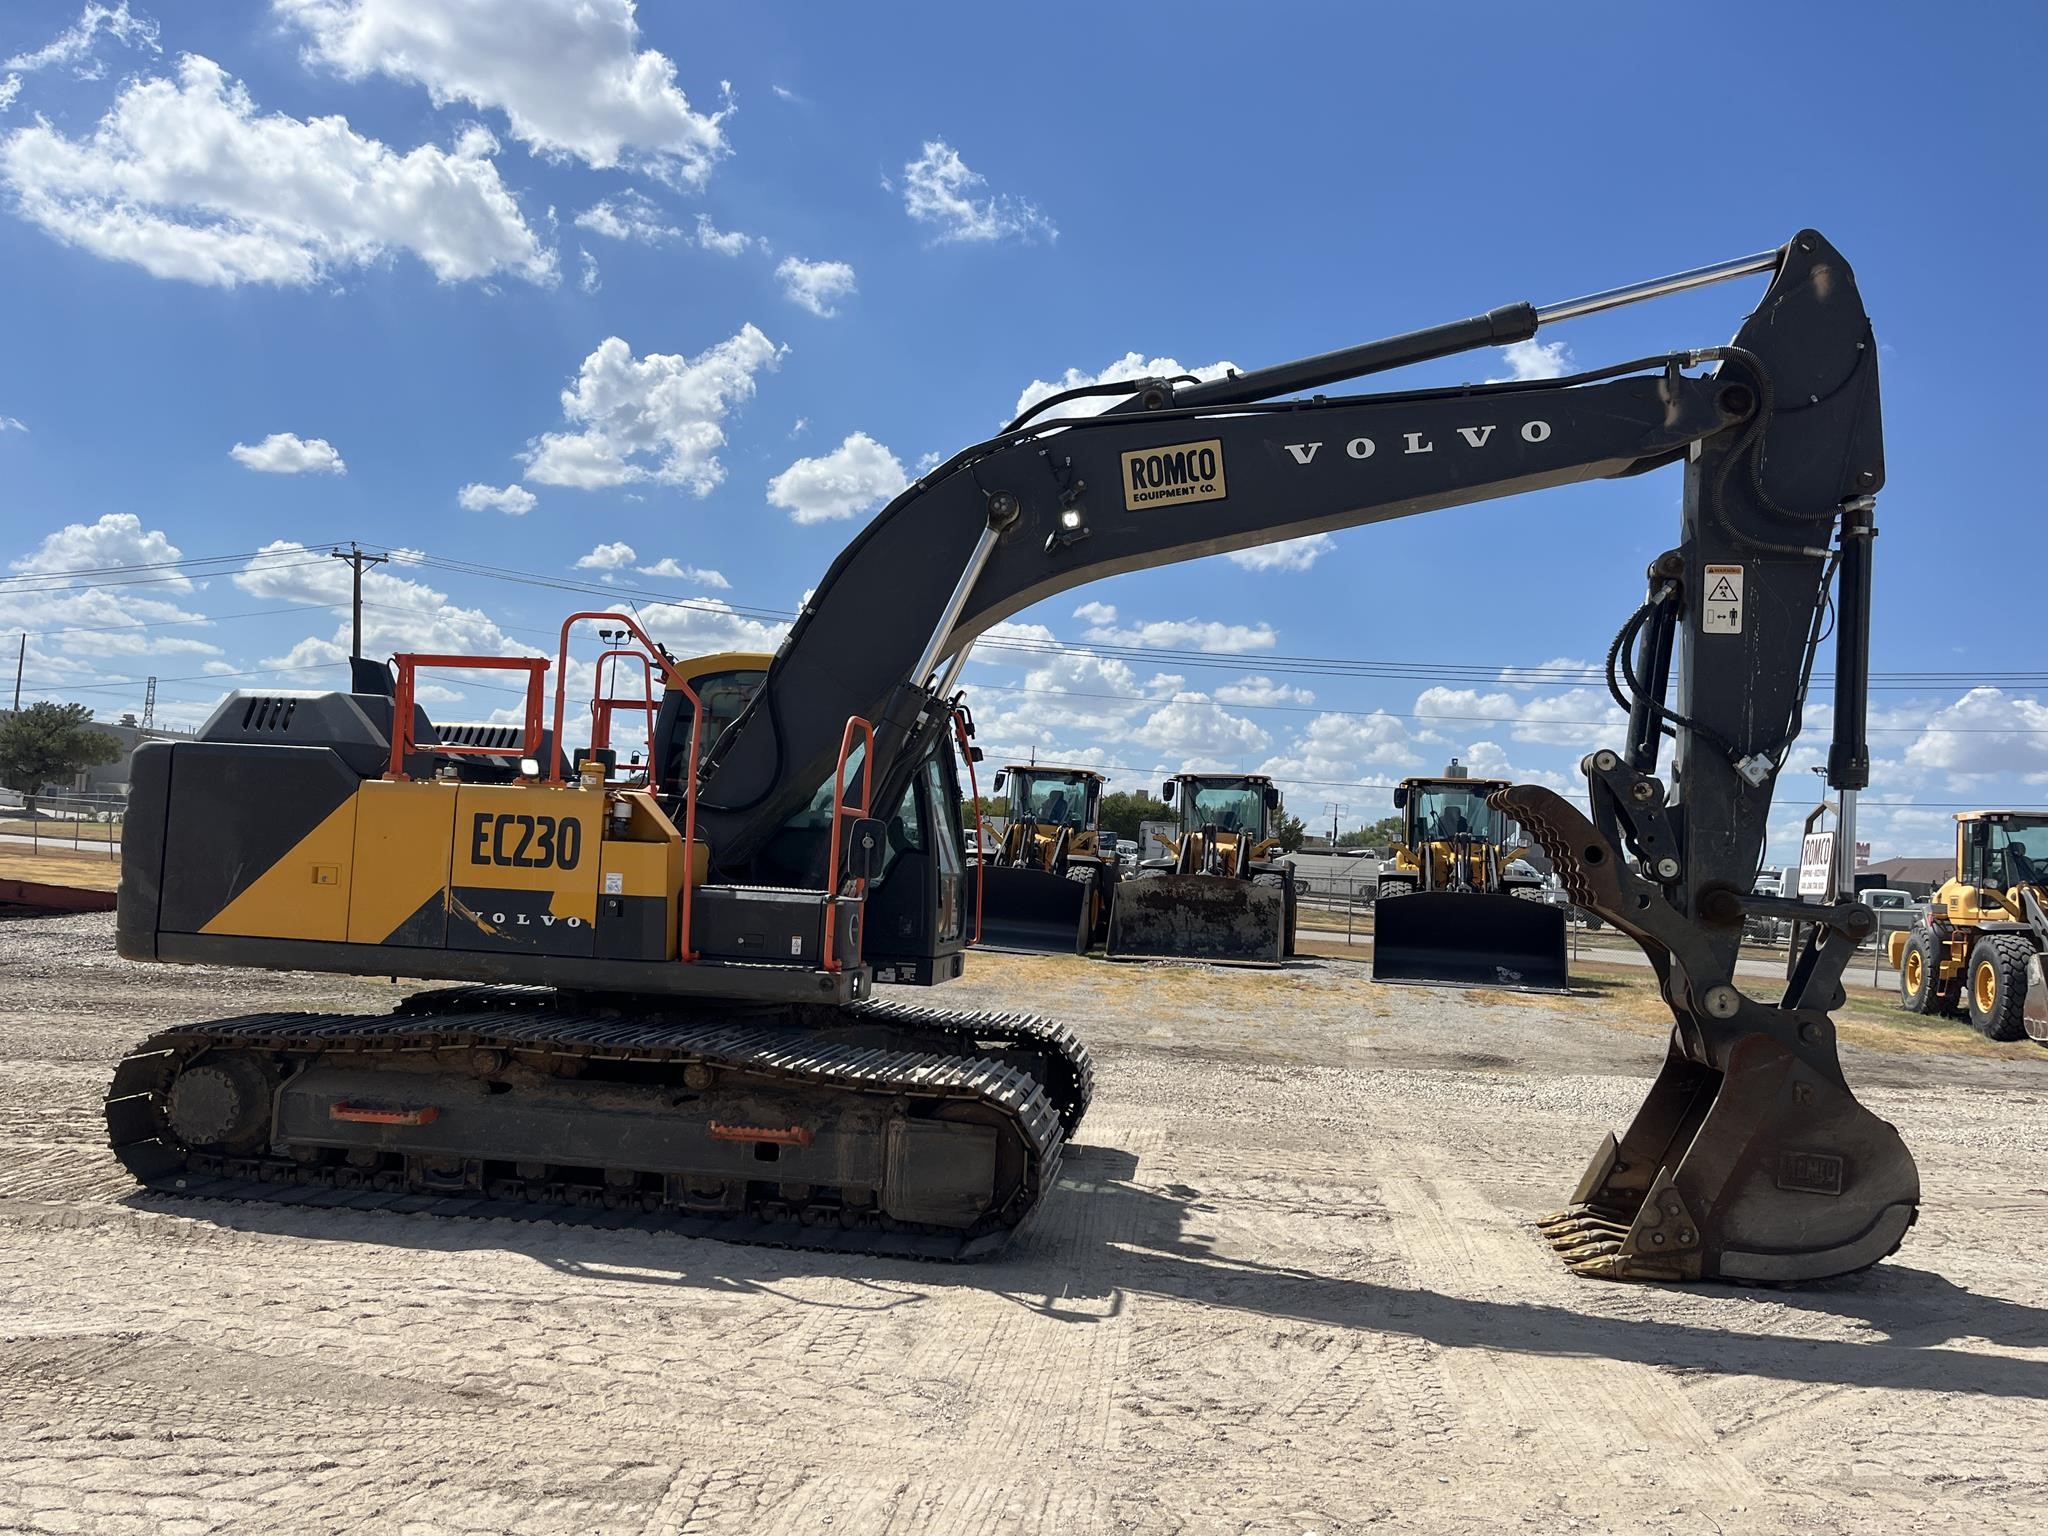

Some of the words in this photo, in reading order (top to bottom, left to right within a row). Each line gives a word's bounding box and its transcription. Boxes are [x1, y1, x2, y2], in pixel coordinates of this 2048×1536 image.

[1284, 420, 1551, 464] VOLVO
[1130, 448, 1216, 490] ROMCO
[1133, 486, 1195, 502] EQUIPMENT
[1200, 484, 1216, 493] CO.
[471, 812, 581, 870] EC230
[1803, 838, 1830, 866] ROMCO
